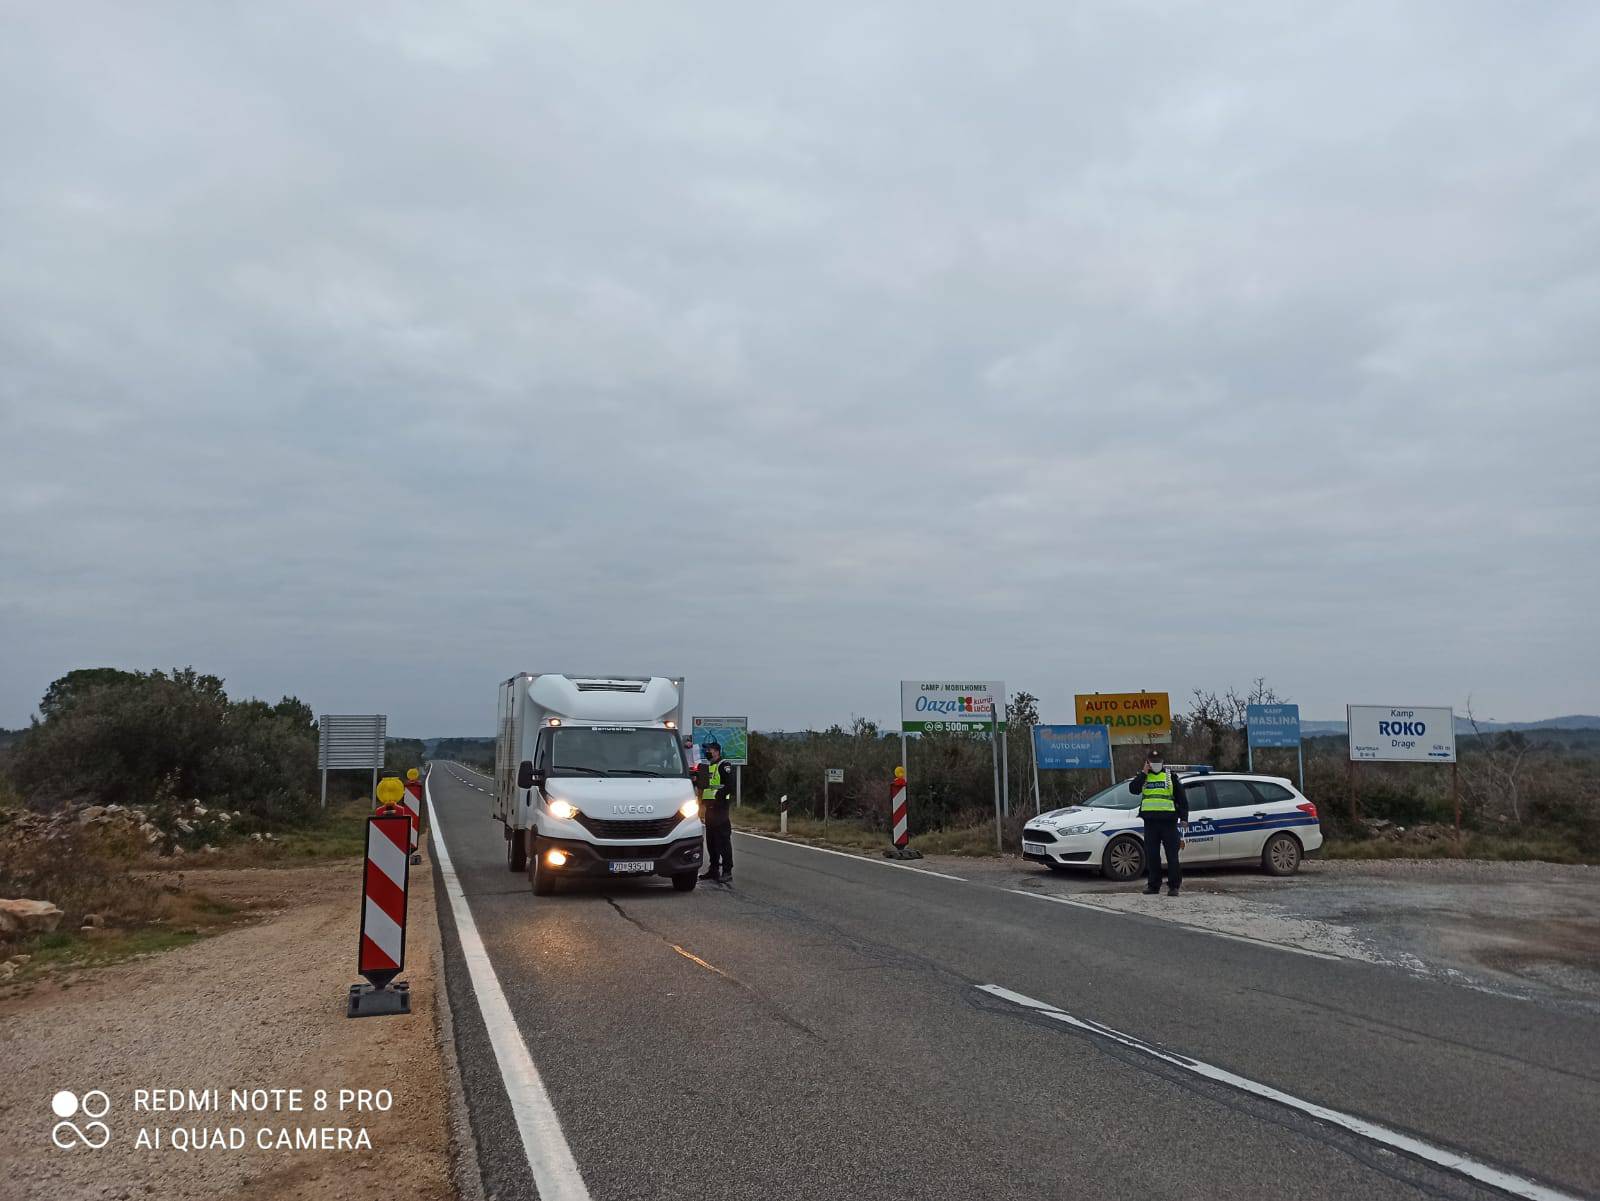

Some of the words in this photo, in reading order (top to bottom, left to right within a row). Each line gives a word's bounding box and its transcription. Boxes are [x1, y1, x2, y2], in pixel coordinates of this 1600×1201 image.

[915, 695, 957, 714] Oaza
[1086, 701, 1118, 711] AUTO
[1123, 699, 1158, 710] CAMP
[1390, 709, 1414, 718] Kamp
[1083, 714, 1164, 727] PARADISO
[1248, 716, 1298, 725] MASLINA
[945, 722, 969, 731] 500m
[1378, 721, 1426, 737] ROKO
[612, 804, 654, 815] IVECO
